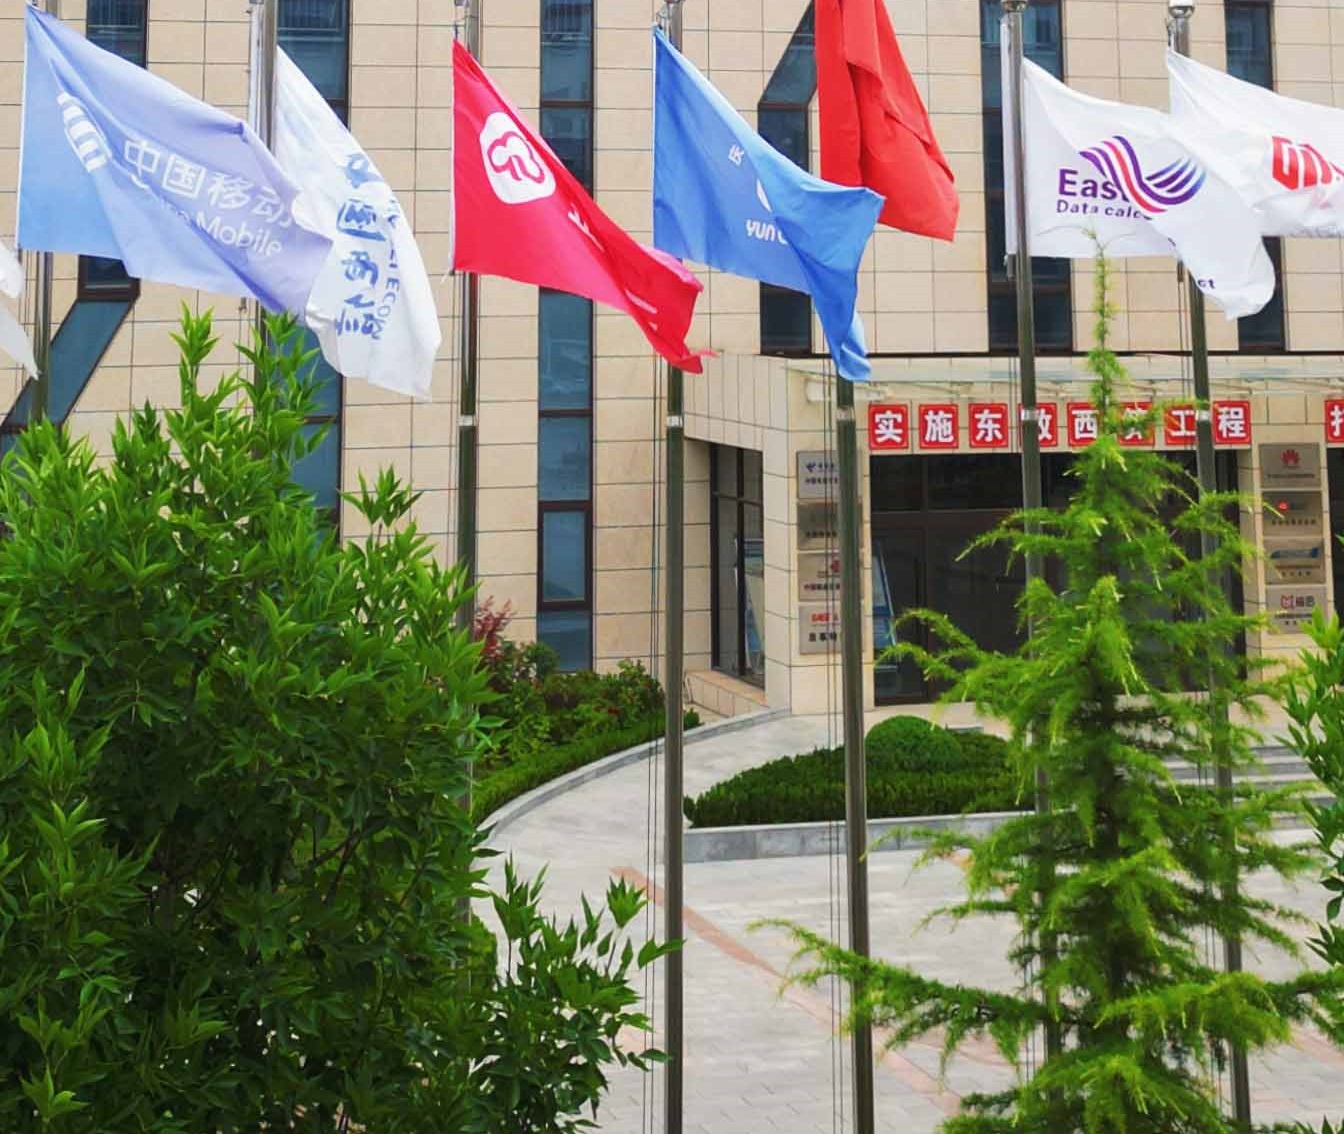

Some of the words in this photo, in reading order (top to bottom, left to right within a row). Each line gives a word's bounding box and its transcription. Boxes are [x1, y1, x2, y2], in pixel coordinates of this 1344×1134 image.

[124, 140, 294, 228] 中国移动
[1056, 199, 1099, 214] Data
[196, 211, 283, 257] Mobile
